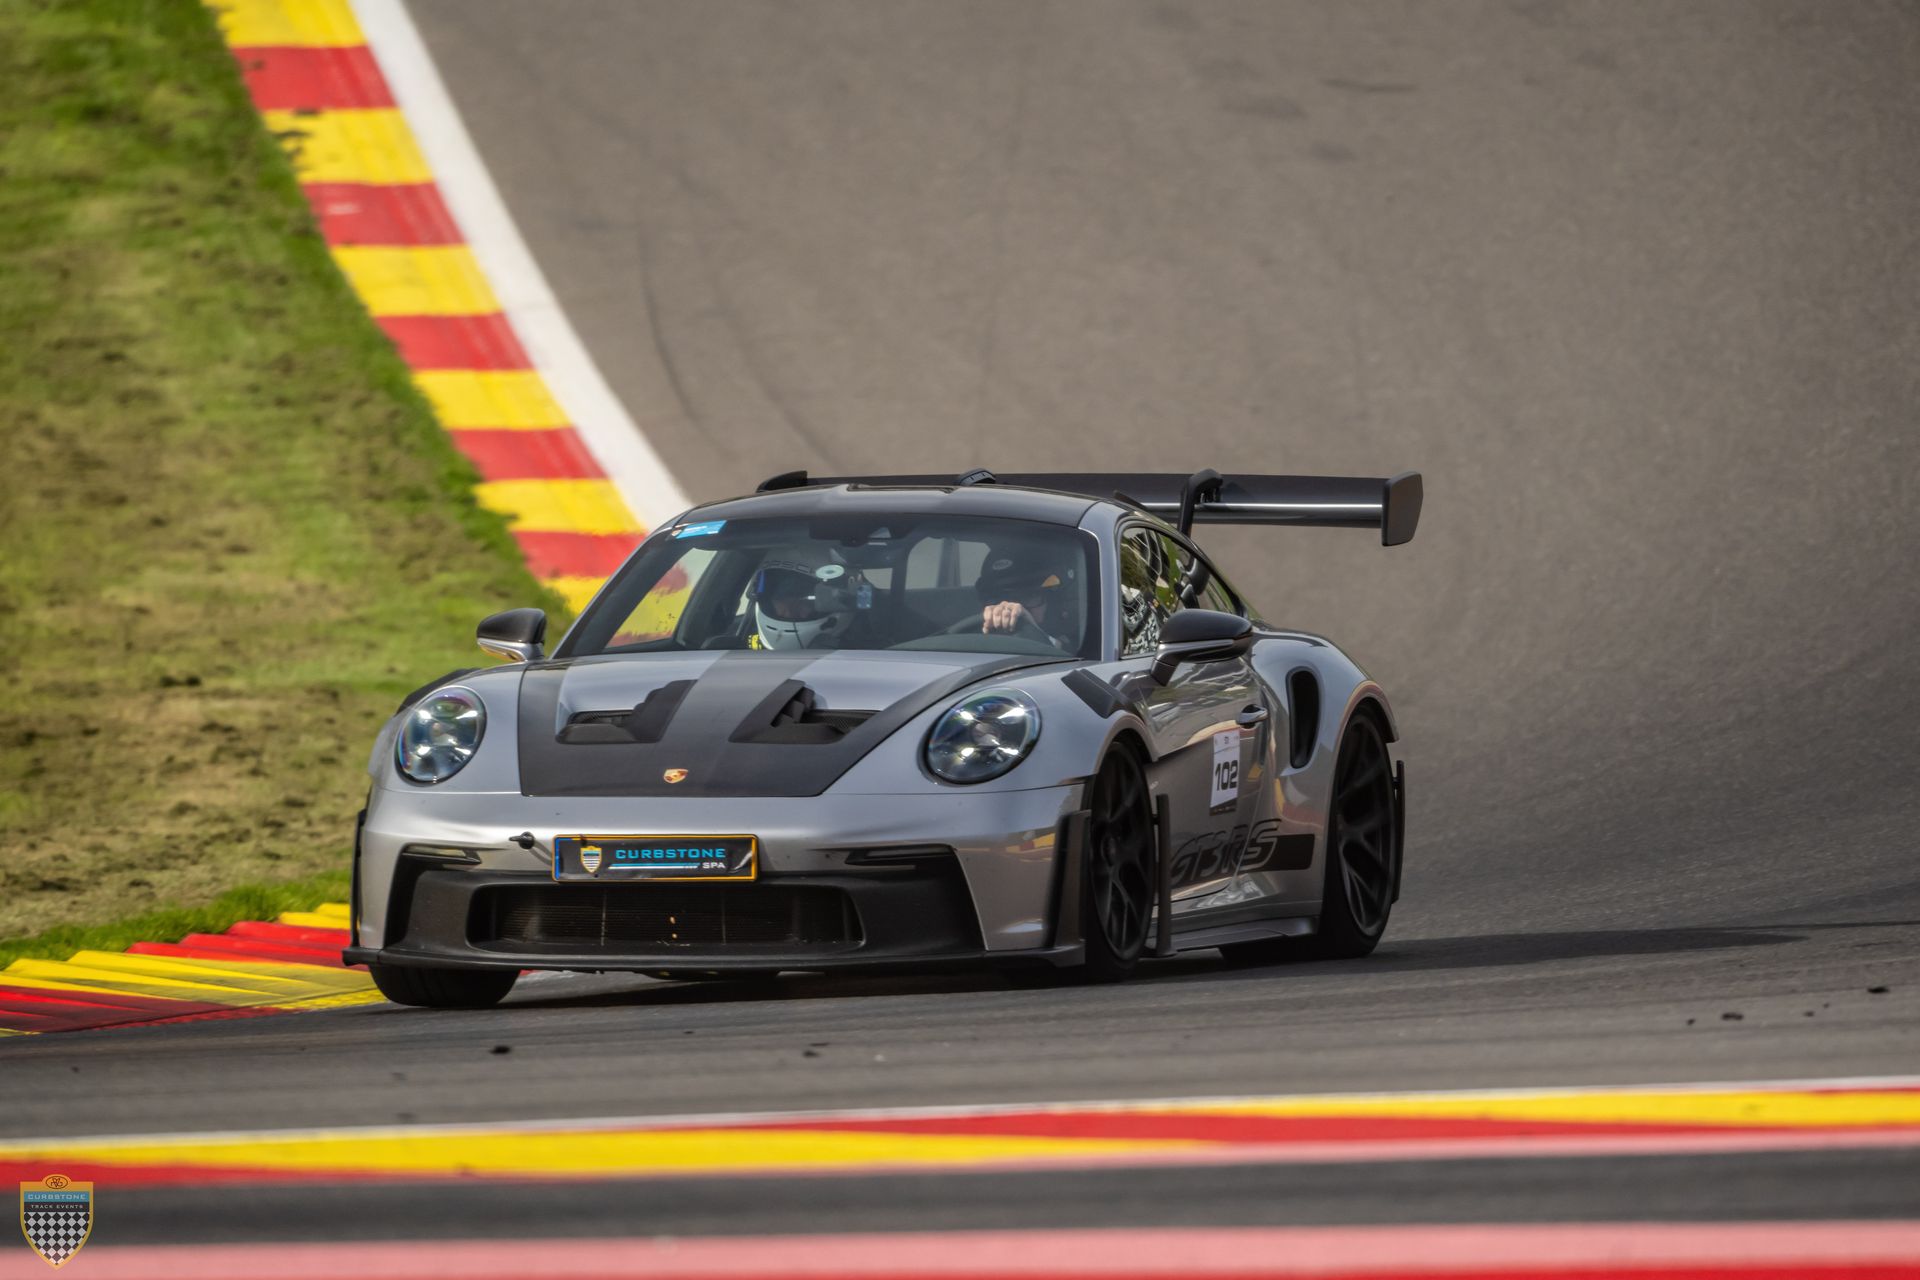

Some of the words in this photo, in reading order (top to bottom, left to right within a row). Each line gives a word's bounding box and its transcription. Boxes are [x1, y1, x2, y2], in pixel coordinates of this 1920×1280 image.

[1214, 760, 1238, 791] 102
[615, 848, 726, 859] CURBSTONE
[702, 861, 726, 869] SPA
